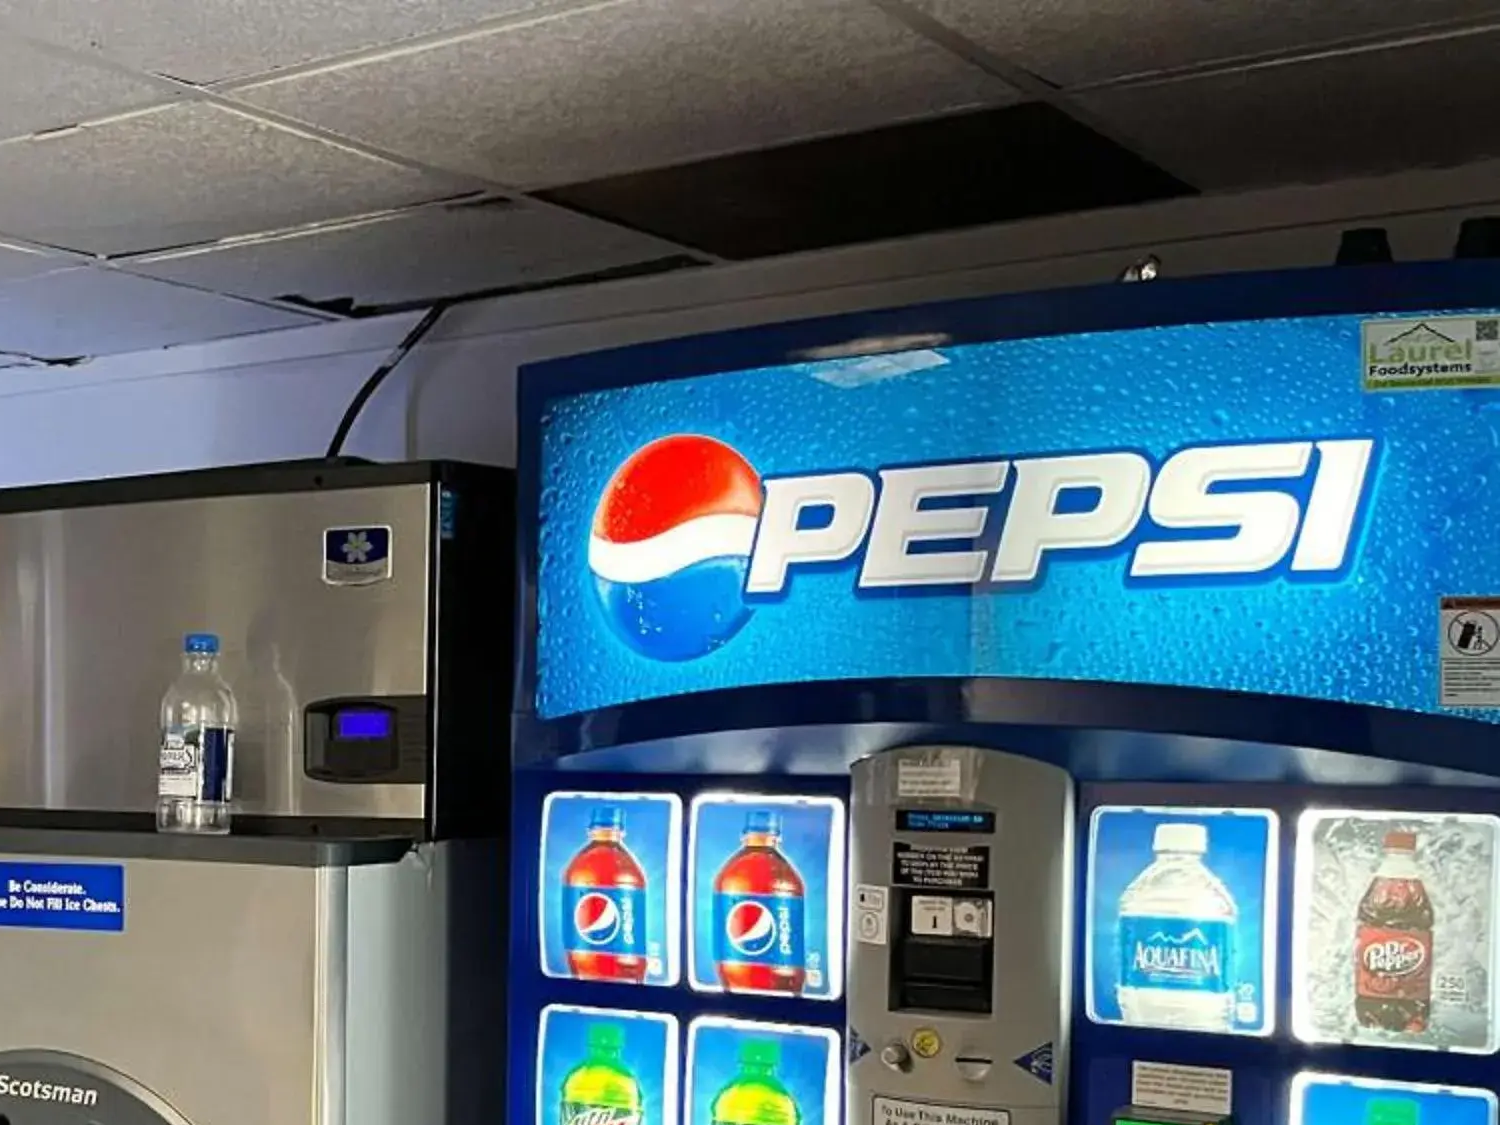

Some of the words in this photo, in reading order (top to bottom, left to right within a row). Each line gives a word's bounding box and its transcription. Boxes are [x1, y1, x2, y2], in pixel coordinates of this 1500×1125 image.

[1369, 339, 1472, 362] Laurel
[1369, 361, 1473, 376] Foodsystems
[746, 439, 1373, 593] PEPSI
[8, 880, 21, 893] Be
[23, 880, 87, 895] Considerate.
[9, 896, 23, 909] Do
[26, 897, 45, 910] Not
[47, 898, 62, 911] Fill
[65, 898, 80, 911] Ice
[1133, 941, 1221, 976] AQUAFINA
[882, 1105, 893, 1116] To
[895, 1107, 915, 1119] Use
[918, 1110, 942, 1123] This
